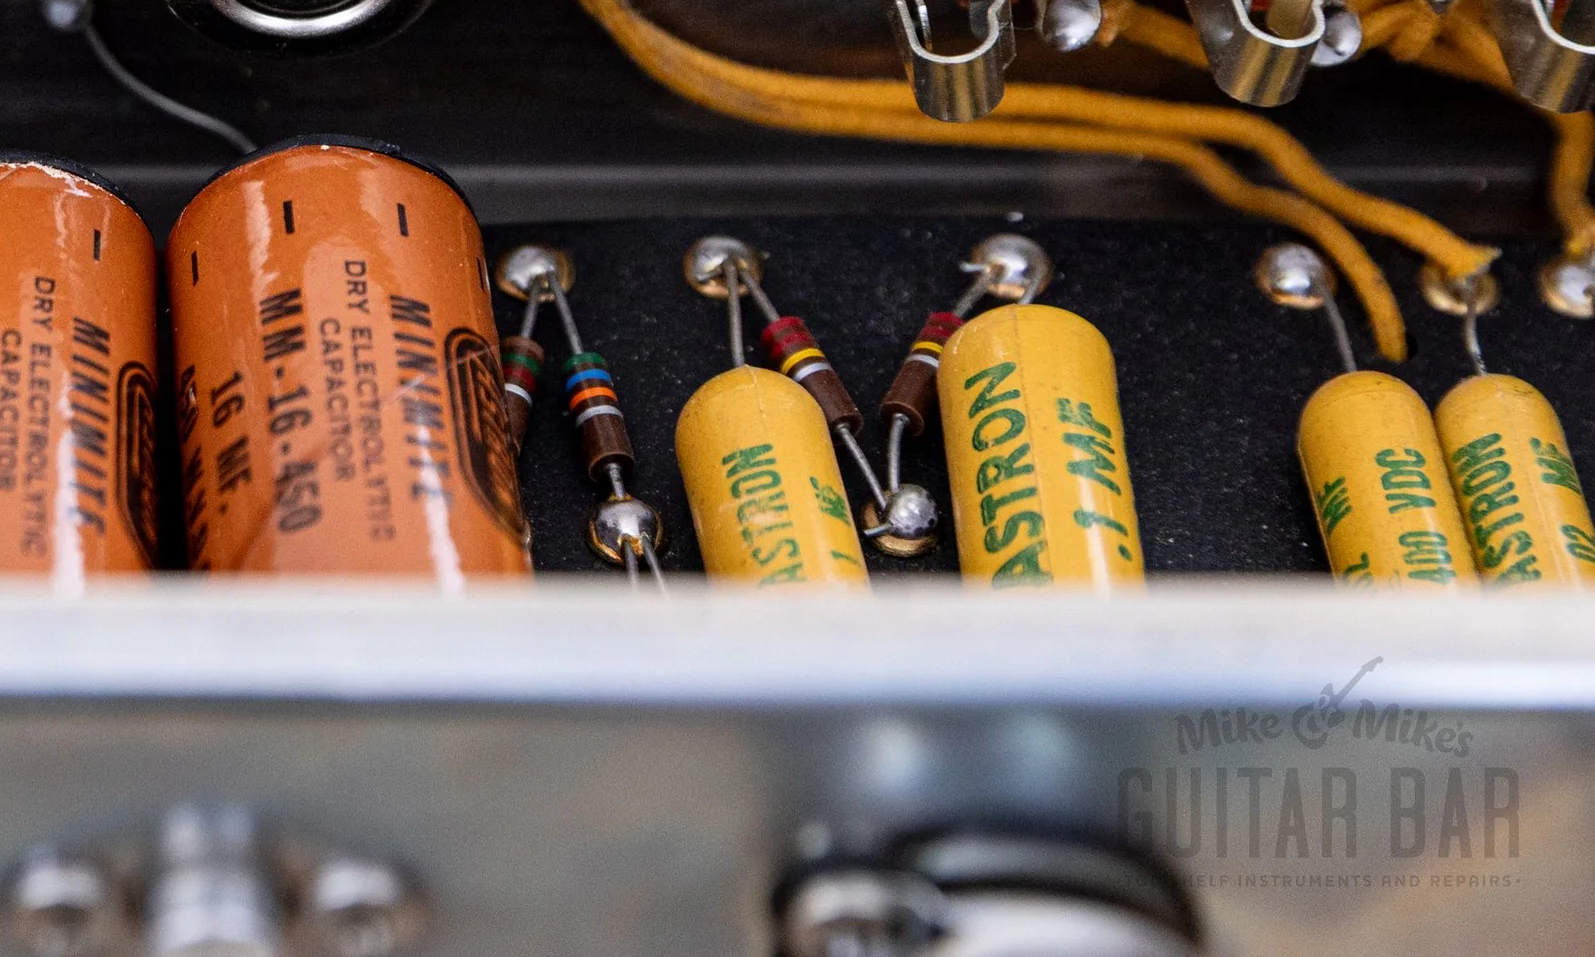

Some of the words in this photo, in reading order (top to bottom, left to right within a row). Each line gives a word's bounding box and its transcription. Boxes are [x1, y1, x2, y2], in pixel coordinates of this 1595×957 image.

[31, 276, 56, 334] DRY
[344, 259, 371, 315] DRY
[66, 316, 111, 536] MINIMITE
[210, 371, 246, 429] 16
[318, 317, 355, 483] CAPACITOR
[721, 444, 808, 586] ASTRON
[964, 361, 1053, 589] ASTRON
[1375, 448, 1437, 516] VDC
[1452, 433, 1542, 585] ASTRON
